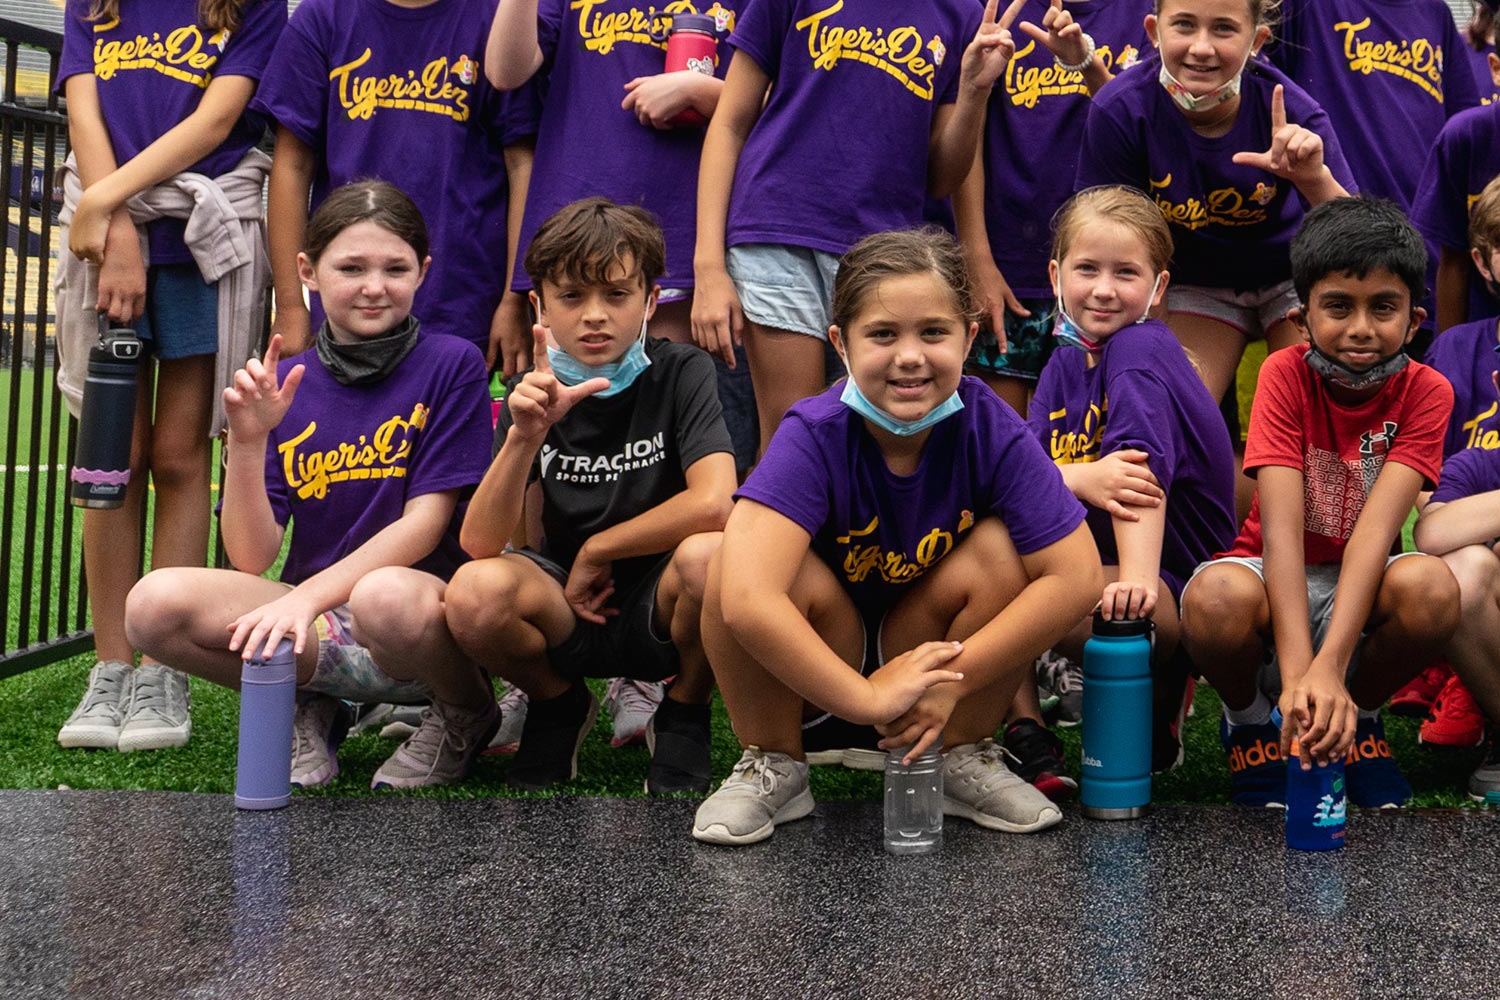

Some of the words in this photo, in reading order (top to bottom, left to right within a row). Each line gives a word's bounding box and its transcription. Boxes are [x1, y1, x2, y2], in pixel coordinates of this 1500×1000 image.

[796, 0, 887, 73] Tiger's
[329, 47, 423, 120] Tiger's
[1005, 39, 1084, 109] Tigers
[277, 421, 377, 500] Tiger's
[555, 471, 600, 483] SPORTS
[557, 431, 665, 473] TRACION
